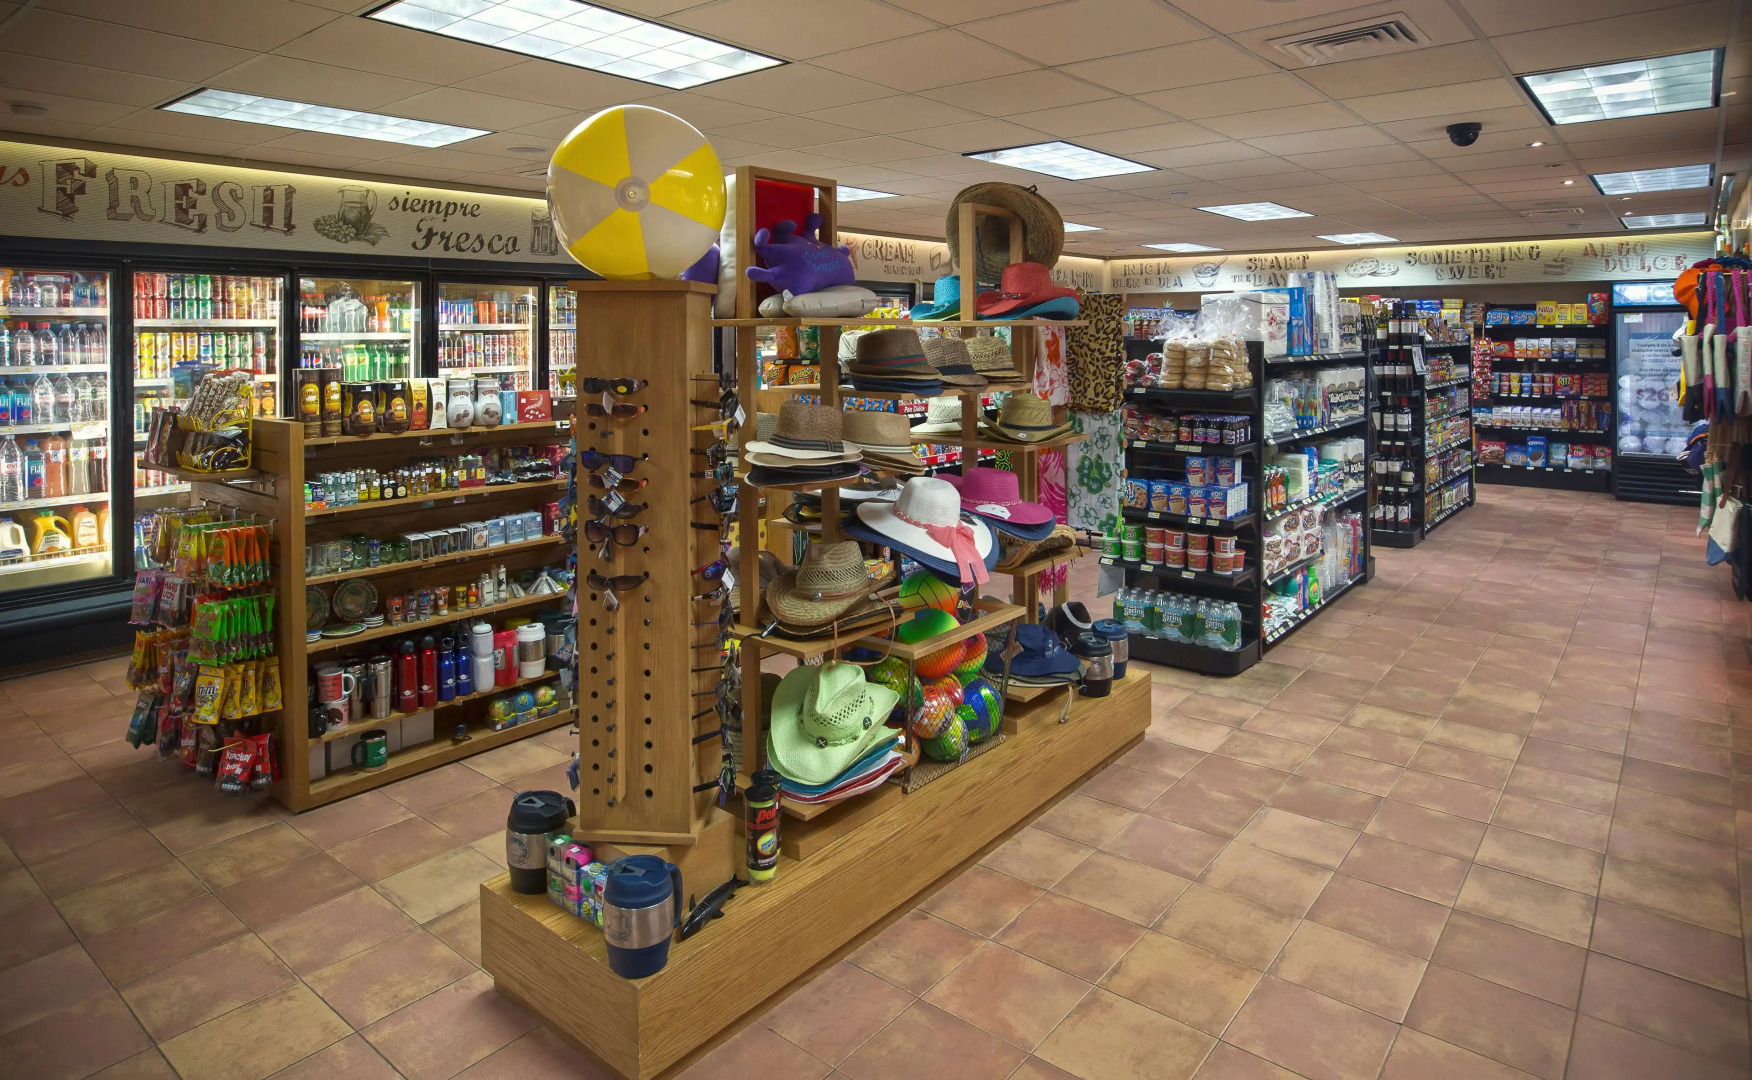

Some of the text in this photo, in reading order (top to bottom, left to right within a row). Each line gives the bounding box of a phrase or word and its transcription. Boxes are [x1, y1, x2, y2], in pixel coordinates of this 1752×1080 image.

[37, 157, 297, 236] FRESH
[388, 191, 482, 222] siempre
[411, 216, 522, 255] Fresco
[862, 239, 917, 264] CREAM
[1405, 244, 1540, 267] SOMETHING
[1583, 241, 1649, 259] ALGO
[1121, 262, 1173, 277] INICIA
[1246, 255, 1310, 273] START
[1600, 254, 1688, 273] DULCE
[1231, 274, 1251, 284] THE
[1435, 263, 1508, 281] SWEET
[1112, 276, 1140, 290] BIEN
[1144, 278, 1155, 287] EL
[78, 287, 90, 296] FIJI
[1537, 306, 1554, 314] Nilla
[1557, 376, 1572, 385] RITZ
[17, 397, 30, 406] FIJI
[30, 465, 43, 474] FIJI
[1124, 607, 1145, 618] Spring
[1162, 611, 1182, 625] Spring
[1205, 619, 1226, 632] Spring
